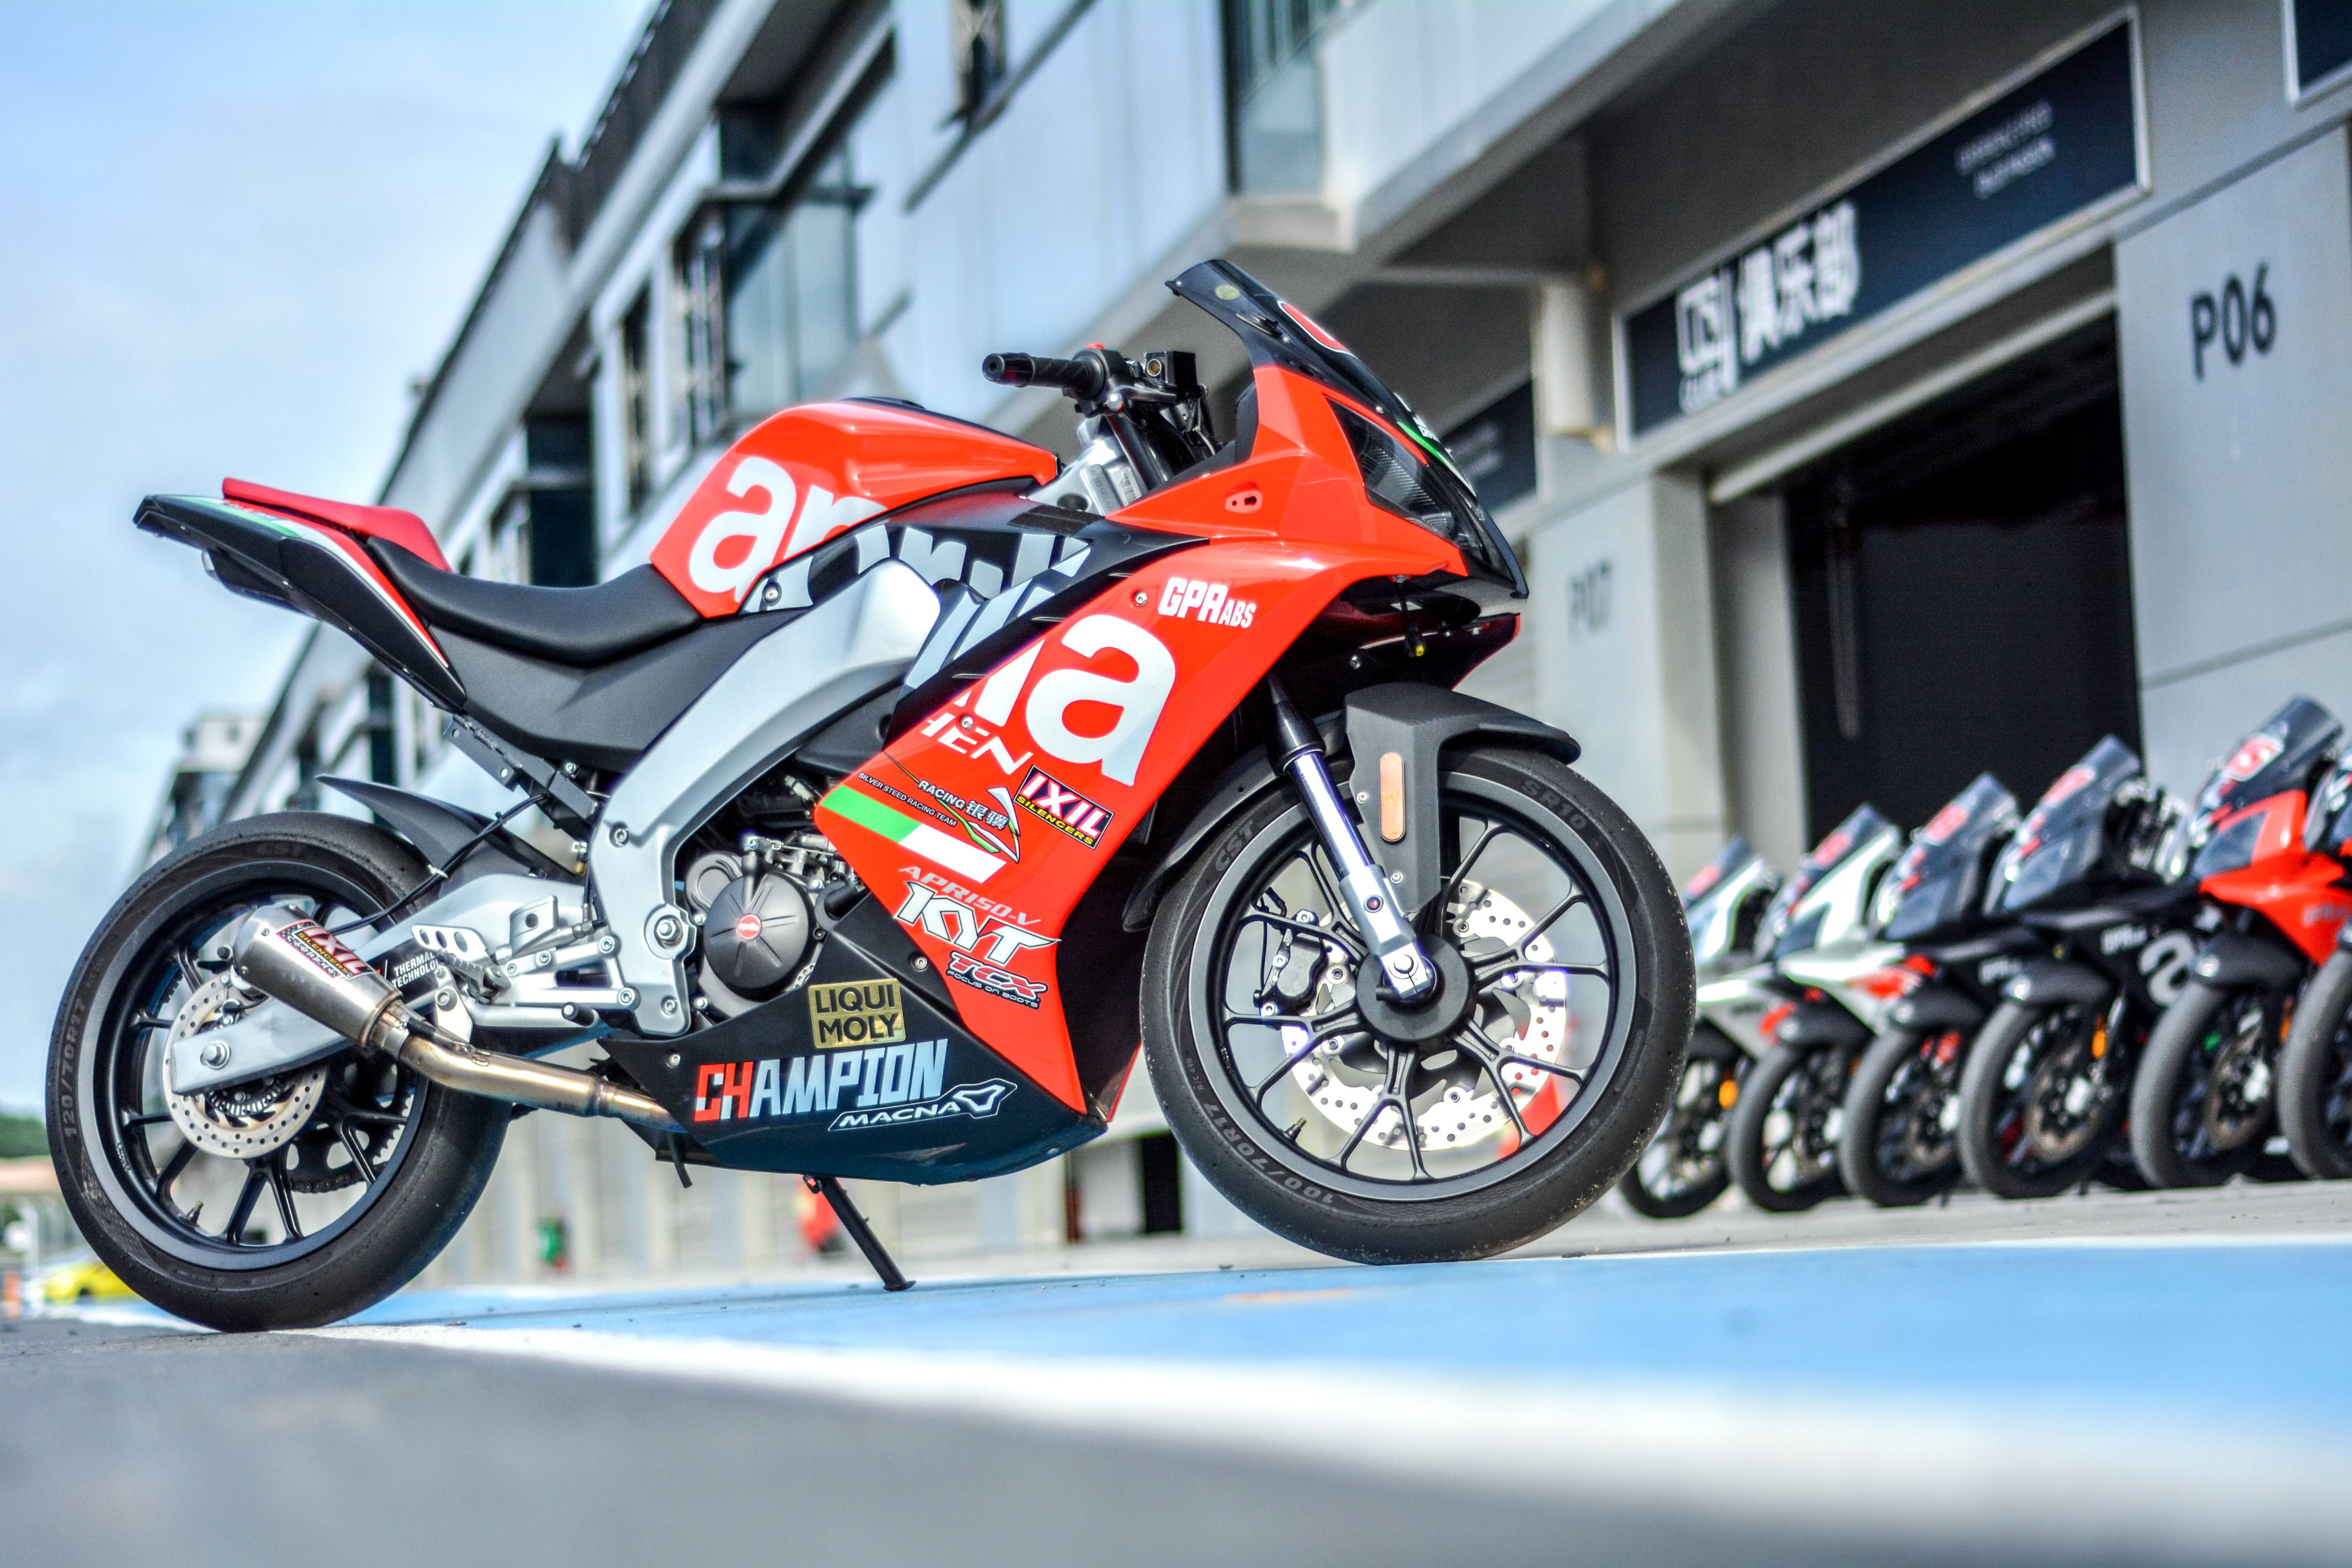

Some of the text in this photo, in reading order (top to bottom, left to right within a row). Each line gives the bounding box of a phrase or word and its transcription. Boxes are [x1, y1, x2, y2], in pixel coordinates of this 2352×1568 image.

[2190, 262, 2277, 382] P06
[858, 772, 957, 827] SILVER STEED RACING TEAM
[918, 780, 965, 810] RACING
[1020, 772, 1107, 840] IXIL
[1016, 795, 1094, 845] SILENCERS
[1215, 819, 1254, 871] CST
[894, 881, 1061, 967] KYT
[287, 935, 335, 974] CARRERA
[298, 932, 349, 974] SILENCERS
[303, 927, 367, 975] IXIL
[392, 958, 439, 988] TECHNOLO
[394, 952, 435, 977] THERMAL
[815, 984, 895, 1013] LIQUI
[948, 971, 982, 988] FOCUS
[1003, 992, 1038, 1008] BOOTS
[950, 951, 1047, 1000] TCX
[818, 1014, 900, 1043] MOLY
[61, 998, 86, 1138] 120/70R17
[694, 1038, 948, 1122] CHAMPION
[839, 1101, 961, 1128] MACNA
[1204, 1103, 1334, 1203] 100/70R17
